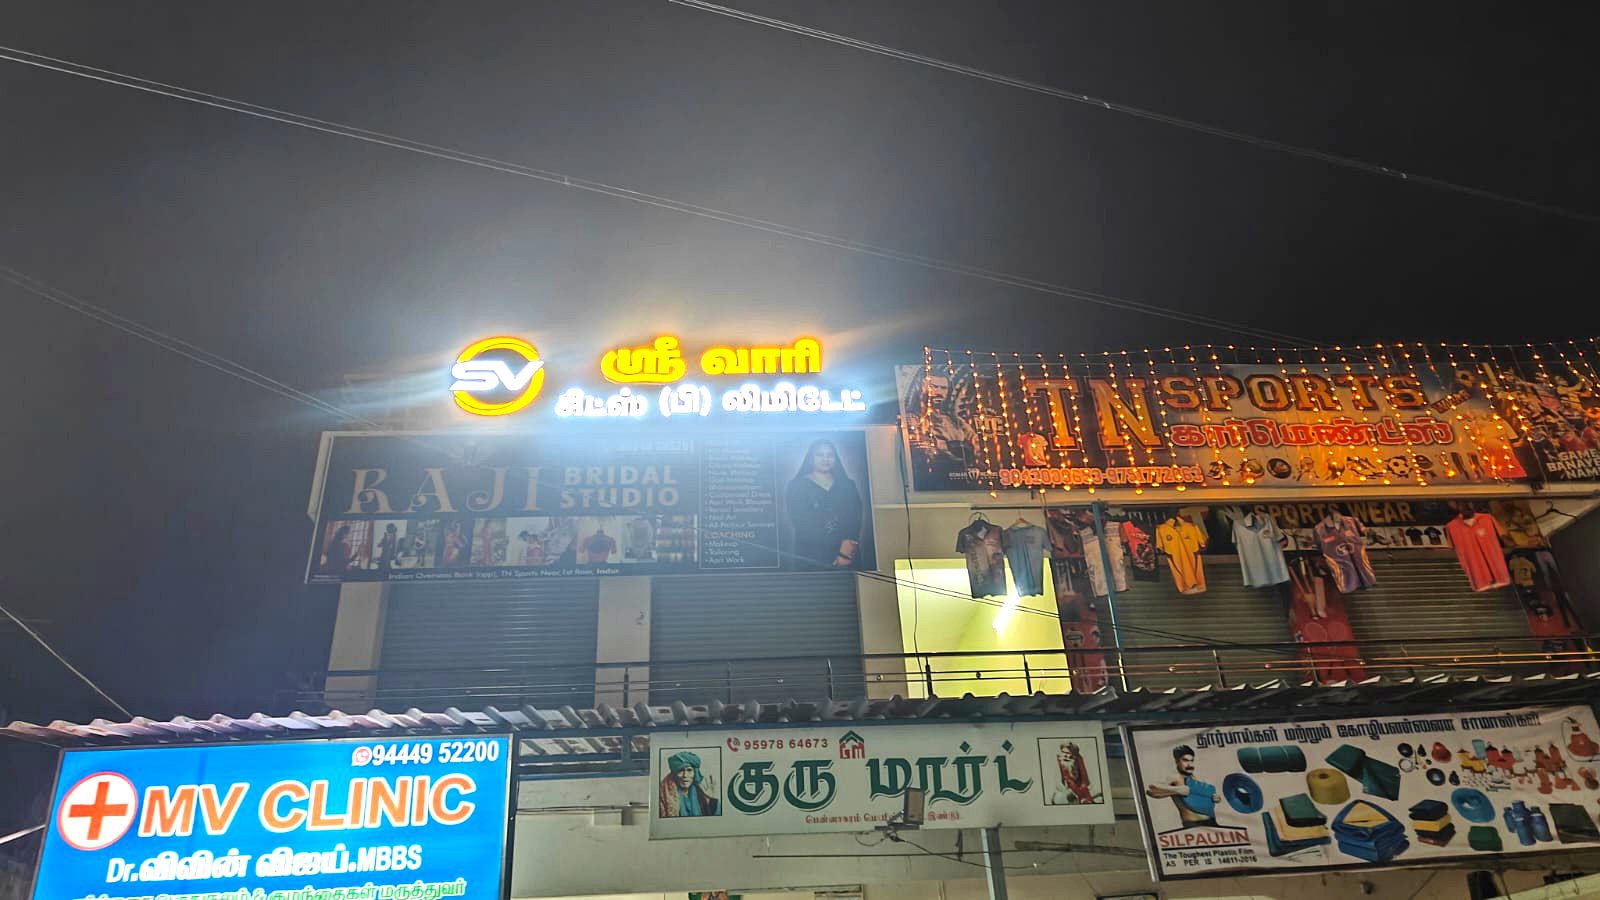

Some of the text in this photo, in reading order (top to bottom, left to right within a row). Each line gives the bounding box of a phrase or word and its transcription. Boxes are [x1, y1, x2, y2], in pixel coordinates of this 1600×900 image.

[601, 336, 822, 384] ஸ்ரீ வாரி
[449, 361, 544, 391] SV
[1160, 373, 1426, 412] SPORTS
[1024, 374, 1166, 452] TN
[564, 464, 677, 485] BRIDAL
[343, 466, 546, 515] RAJI
[560, 486, 680, 508] STUDIO
[1347, 500, 1415, 523] WEAR
[743, 738, 829, 750] 95978 64673
[1283, 723, 1332, 744] மற்றும்
[372, 740, 499, 767] 94449 52200
[727, 739, 1035, 815] குரு மார்ட்
[138, 772, 477, 838] MV CLINIC
[1158, 831, 1250, 848] SILPAULIN
[1165, 860, 1177, 868] AS
[1184, 859, 1199, 867] PER
[1179, 850, 1212, 860] Toughest
[1213, 848, 1237, 857] Plastic
